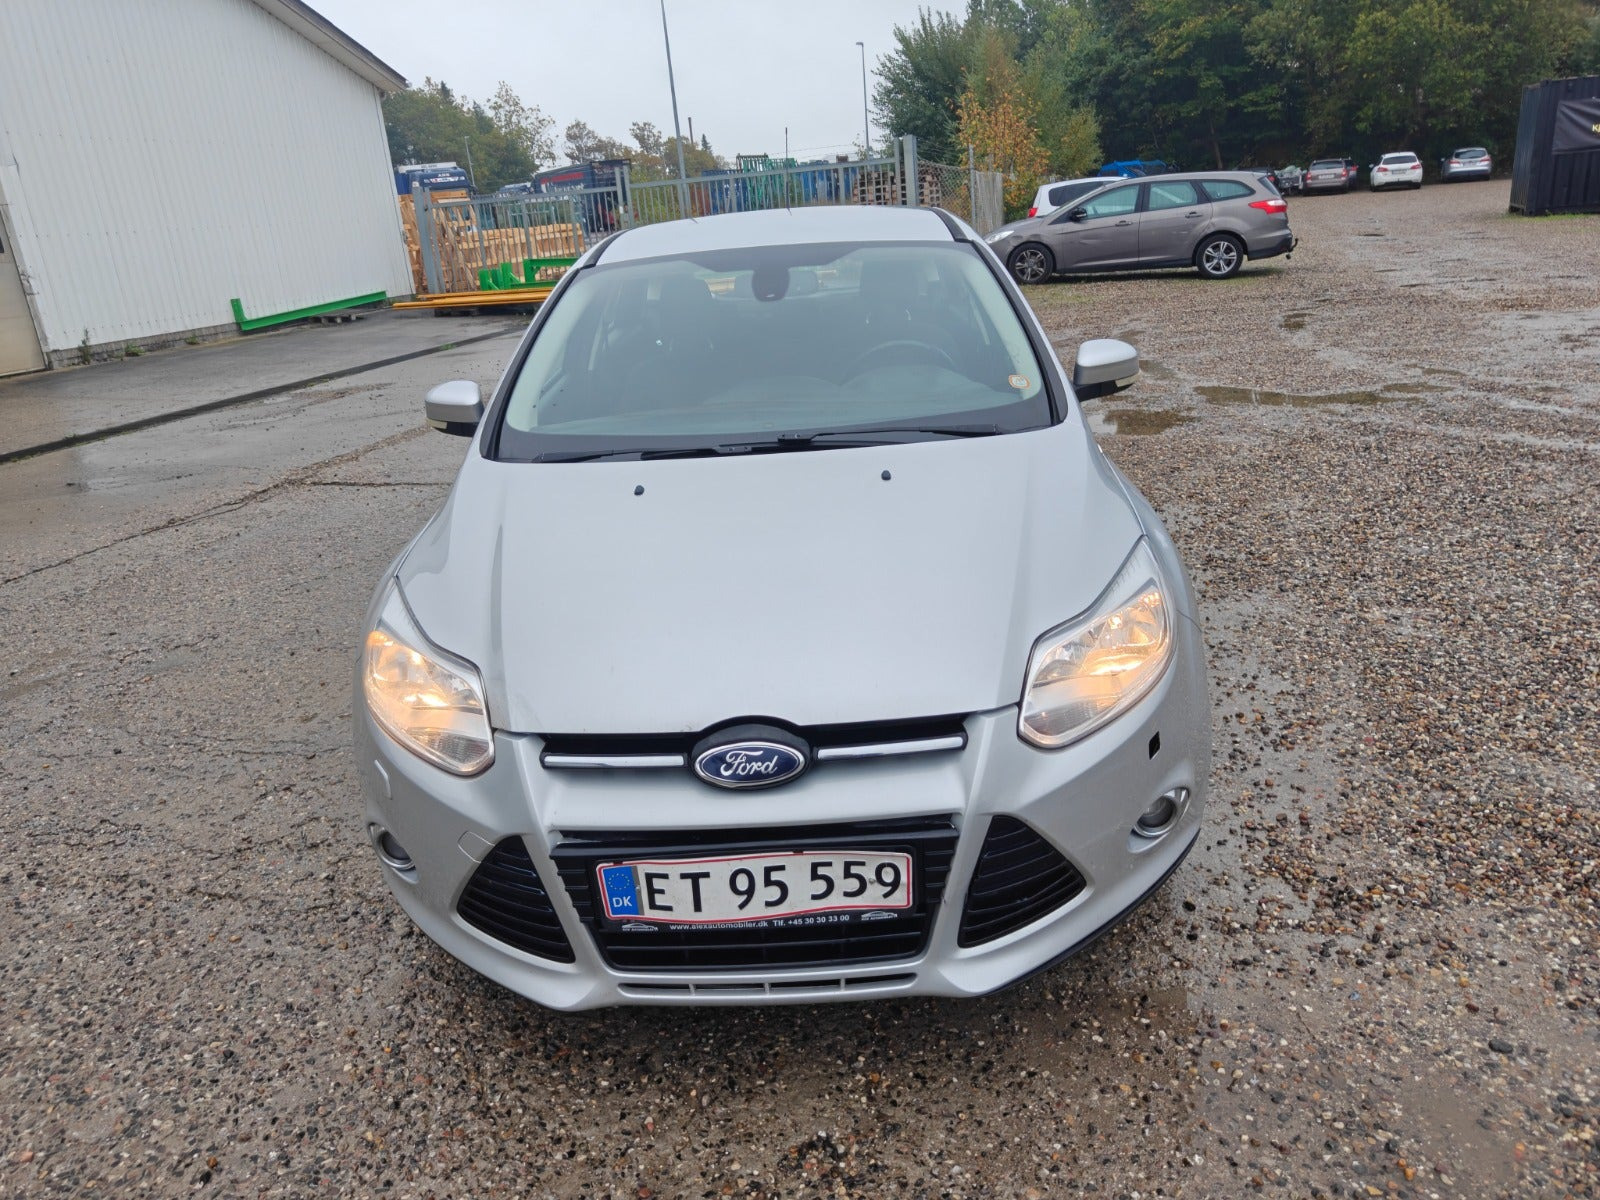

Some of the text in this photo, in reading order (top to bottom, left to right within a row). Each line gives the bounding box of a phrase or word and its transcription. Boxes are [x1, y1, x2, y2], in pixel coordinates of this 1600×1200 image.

[720, 750, 778, 776] Ford
[645, 861, 902, 913] ET 95 559
[612, 895, 633, 908] DK
